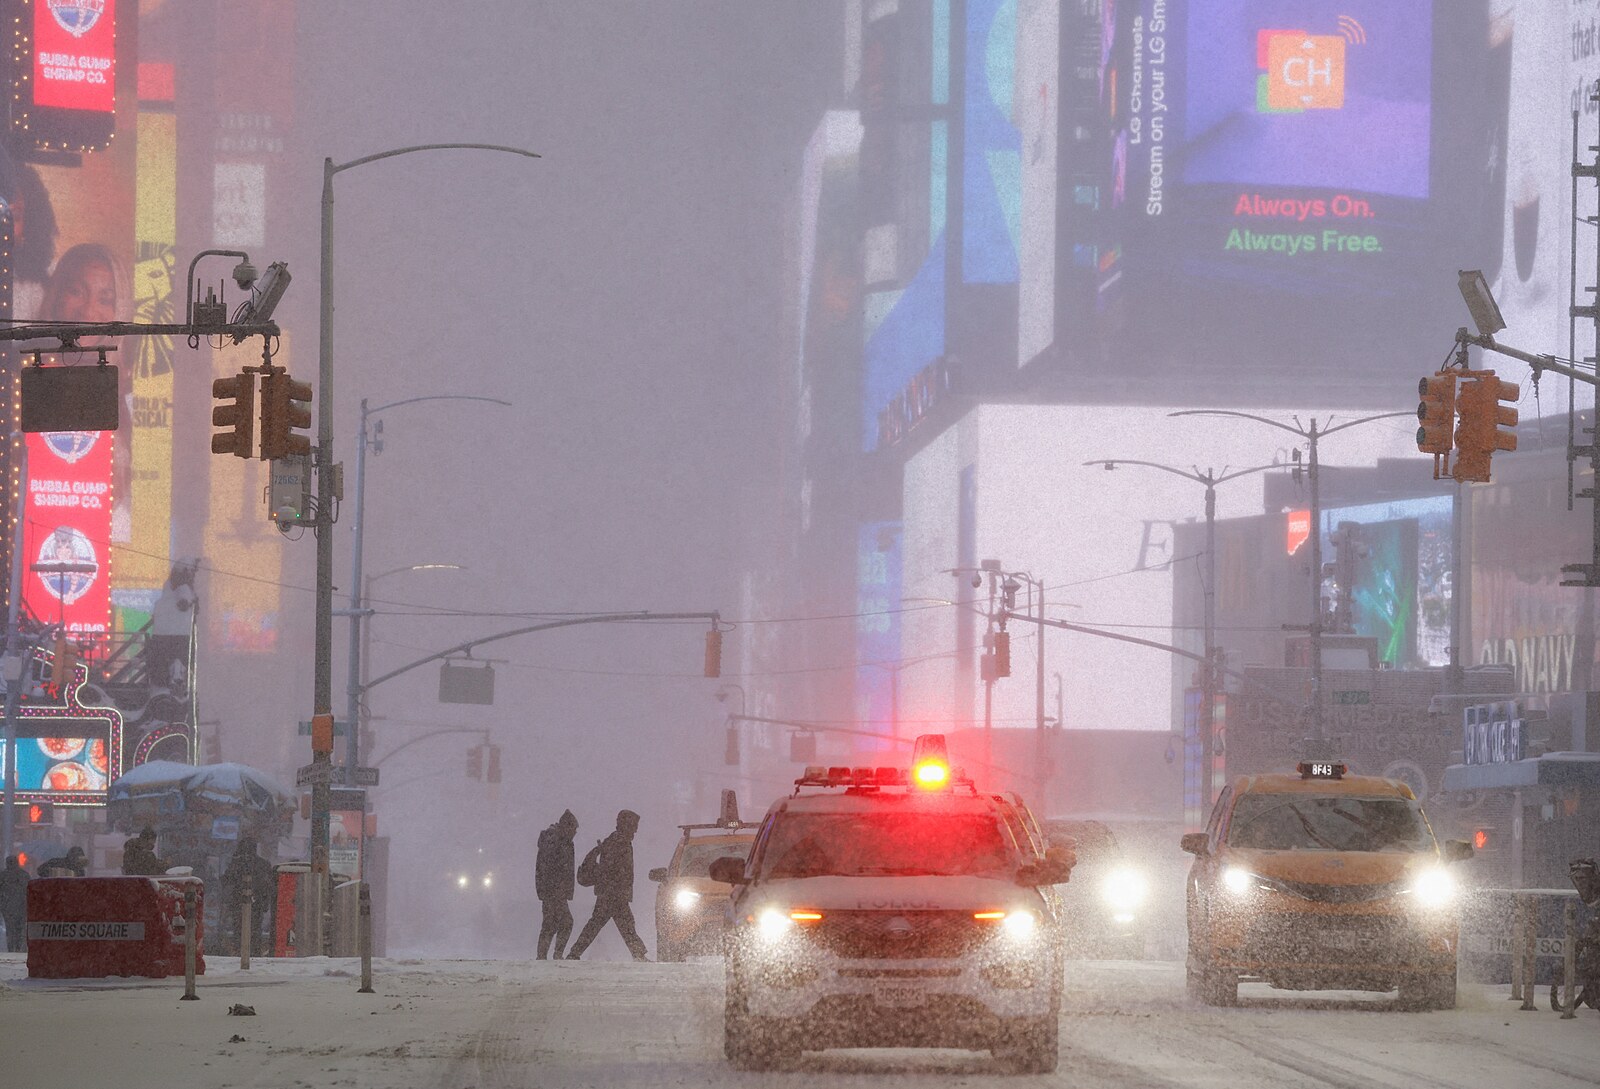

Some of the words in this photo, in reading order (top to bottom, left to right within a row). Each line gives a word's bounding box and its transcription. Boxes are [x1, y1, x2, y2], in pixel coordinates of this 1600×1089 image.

[1149, 36, 1166, 64] LG
[1571, 17, 1596, 61] that
[39, 51, 77, 67] BUBBA
[78, 56, 111, 70] GUMP
[1131, 15, 1143, 113] Channels
[1282, 57, 1331, 87] CH
[43, 67, 85, 82] SHRIMP
[86, 71, 107, 84] CO.
[1151, 68, 1168, 112] your
[1130, 117, 1141, 144] LG
[1150, 116, 1164, 141] on
[1146, 146, 1163, 215] Stream
[1234, 193, 1327, 222] Always
[1331, 194, 1375, 218] On.
[1224, 228, 1317, 257] Always
[1322, 230, 1383, 252] Free.
[30, 479, 71, 493] BUBBA
[72, 481, 108, 494] GUMP
[34, 493, 80, 507] SHRIMP
[81, 495, 102, 509] CO.
[1521, 634, 1576, 692] NAVY
[1312, 764, 1332, 776] 8F43
[40, 923, 77, 938] TIMES
[79, 923, 128, 938] SQUARE
